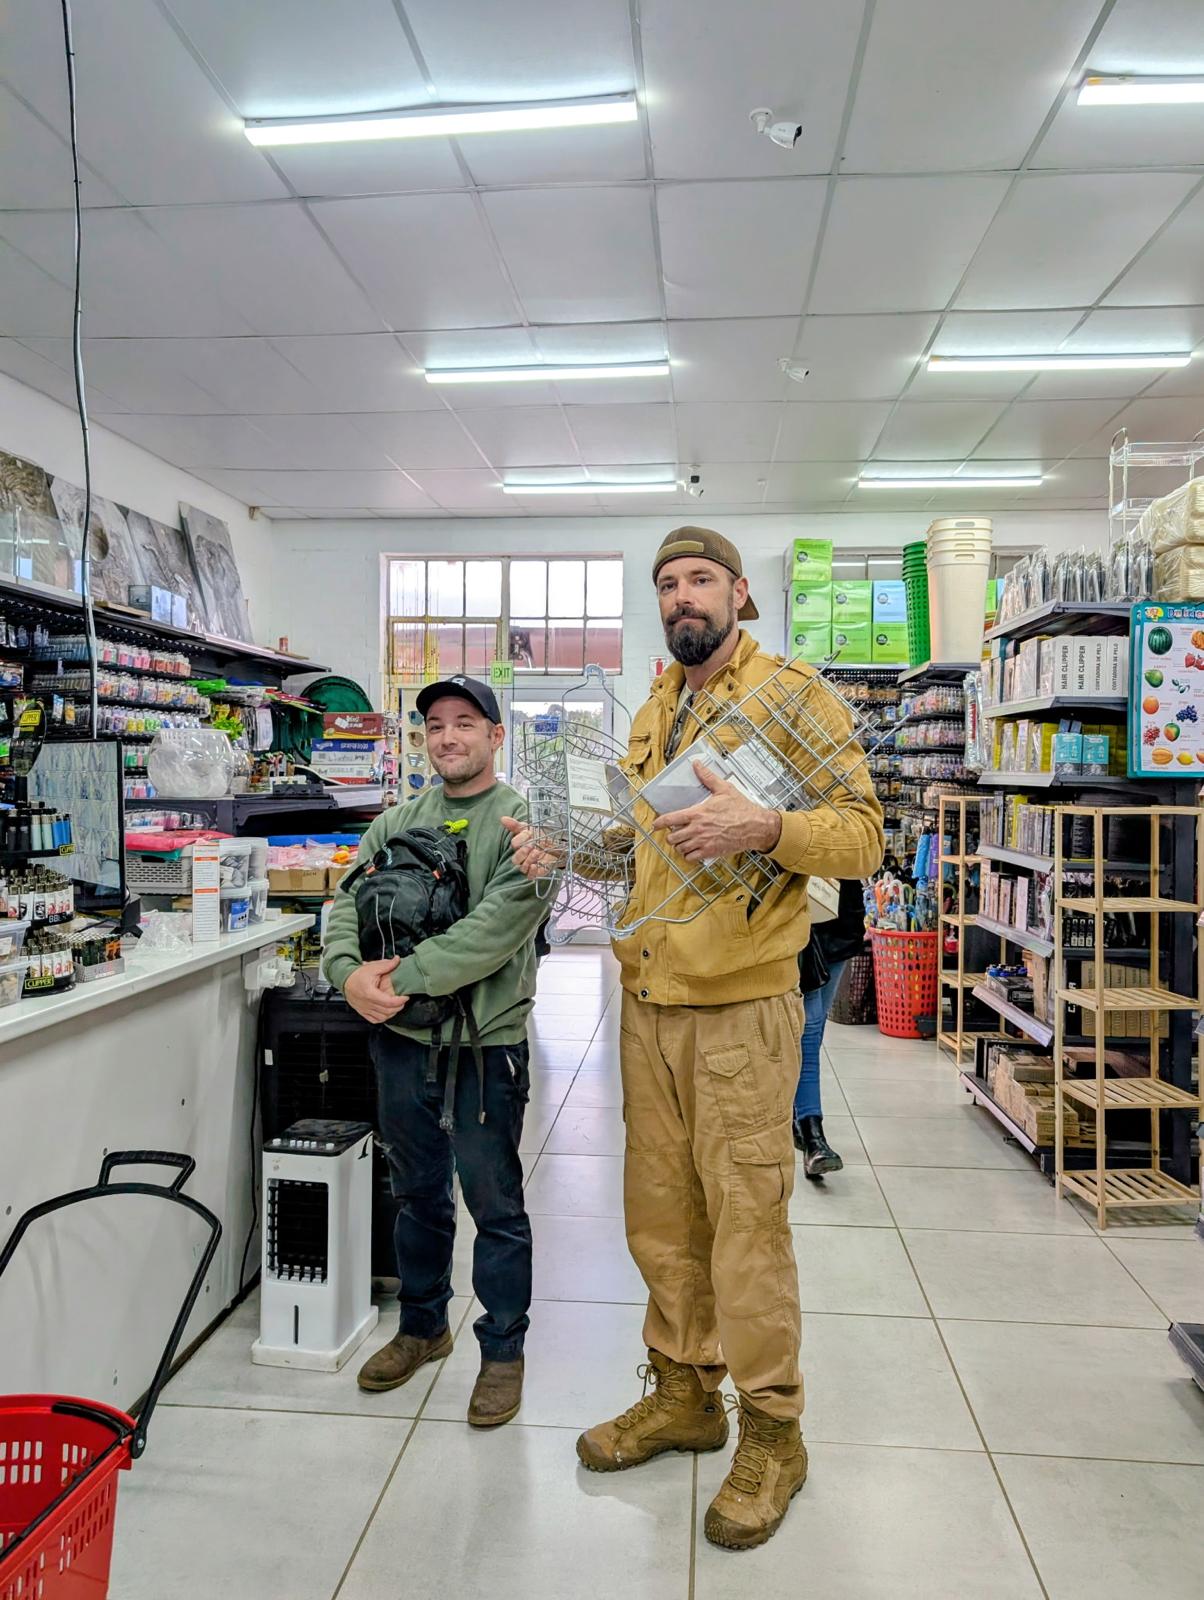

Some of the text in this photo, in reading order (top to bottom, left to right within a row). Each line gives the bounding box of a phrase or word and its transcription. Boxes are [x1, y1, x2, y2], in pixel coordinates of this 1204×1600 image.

[493, 667, 511, 678] EXIT
[1061, 645, 1069, 673] CLIPPER
[1078, 645, 1086, 673] CLIPPER
